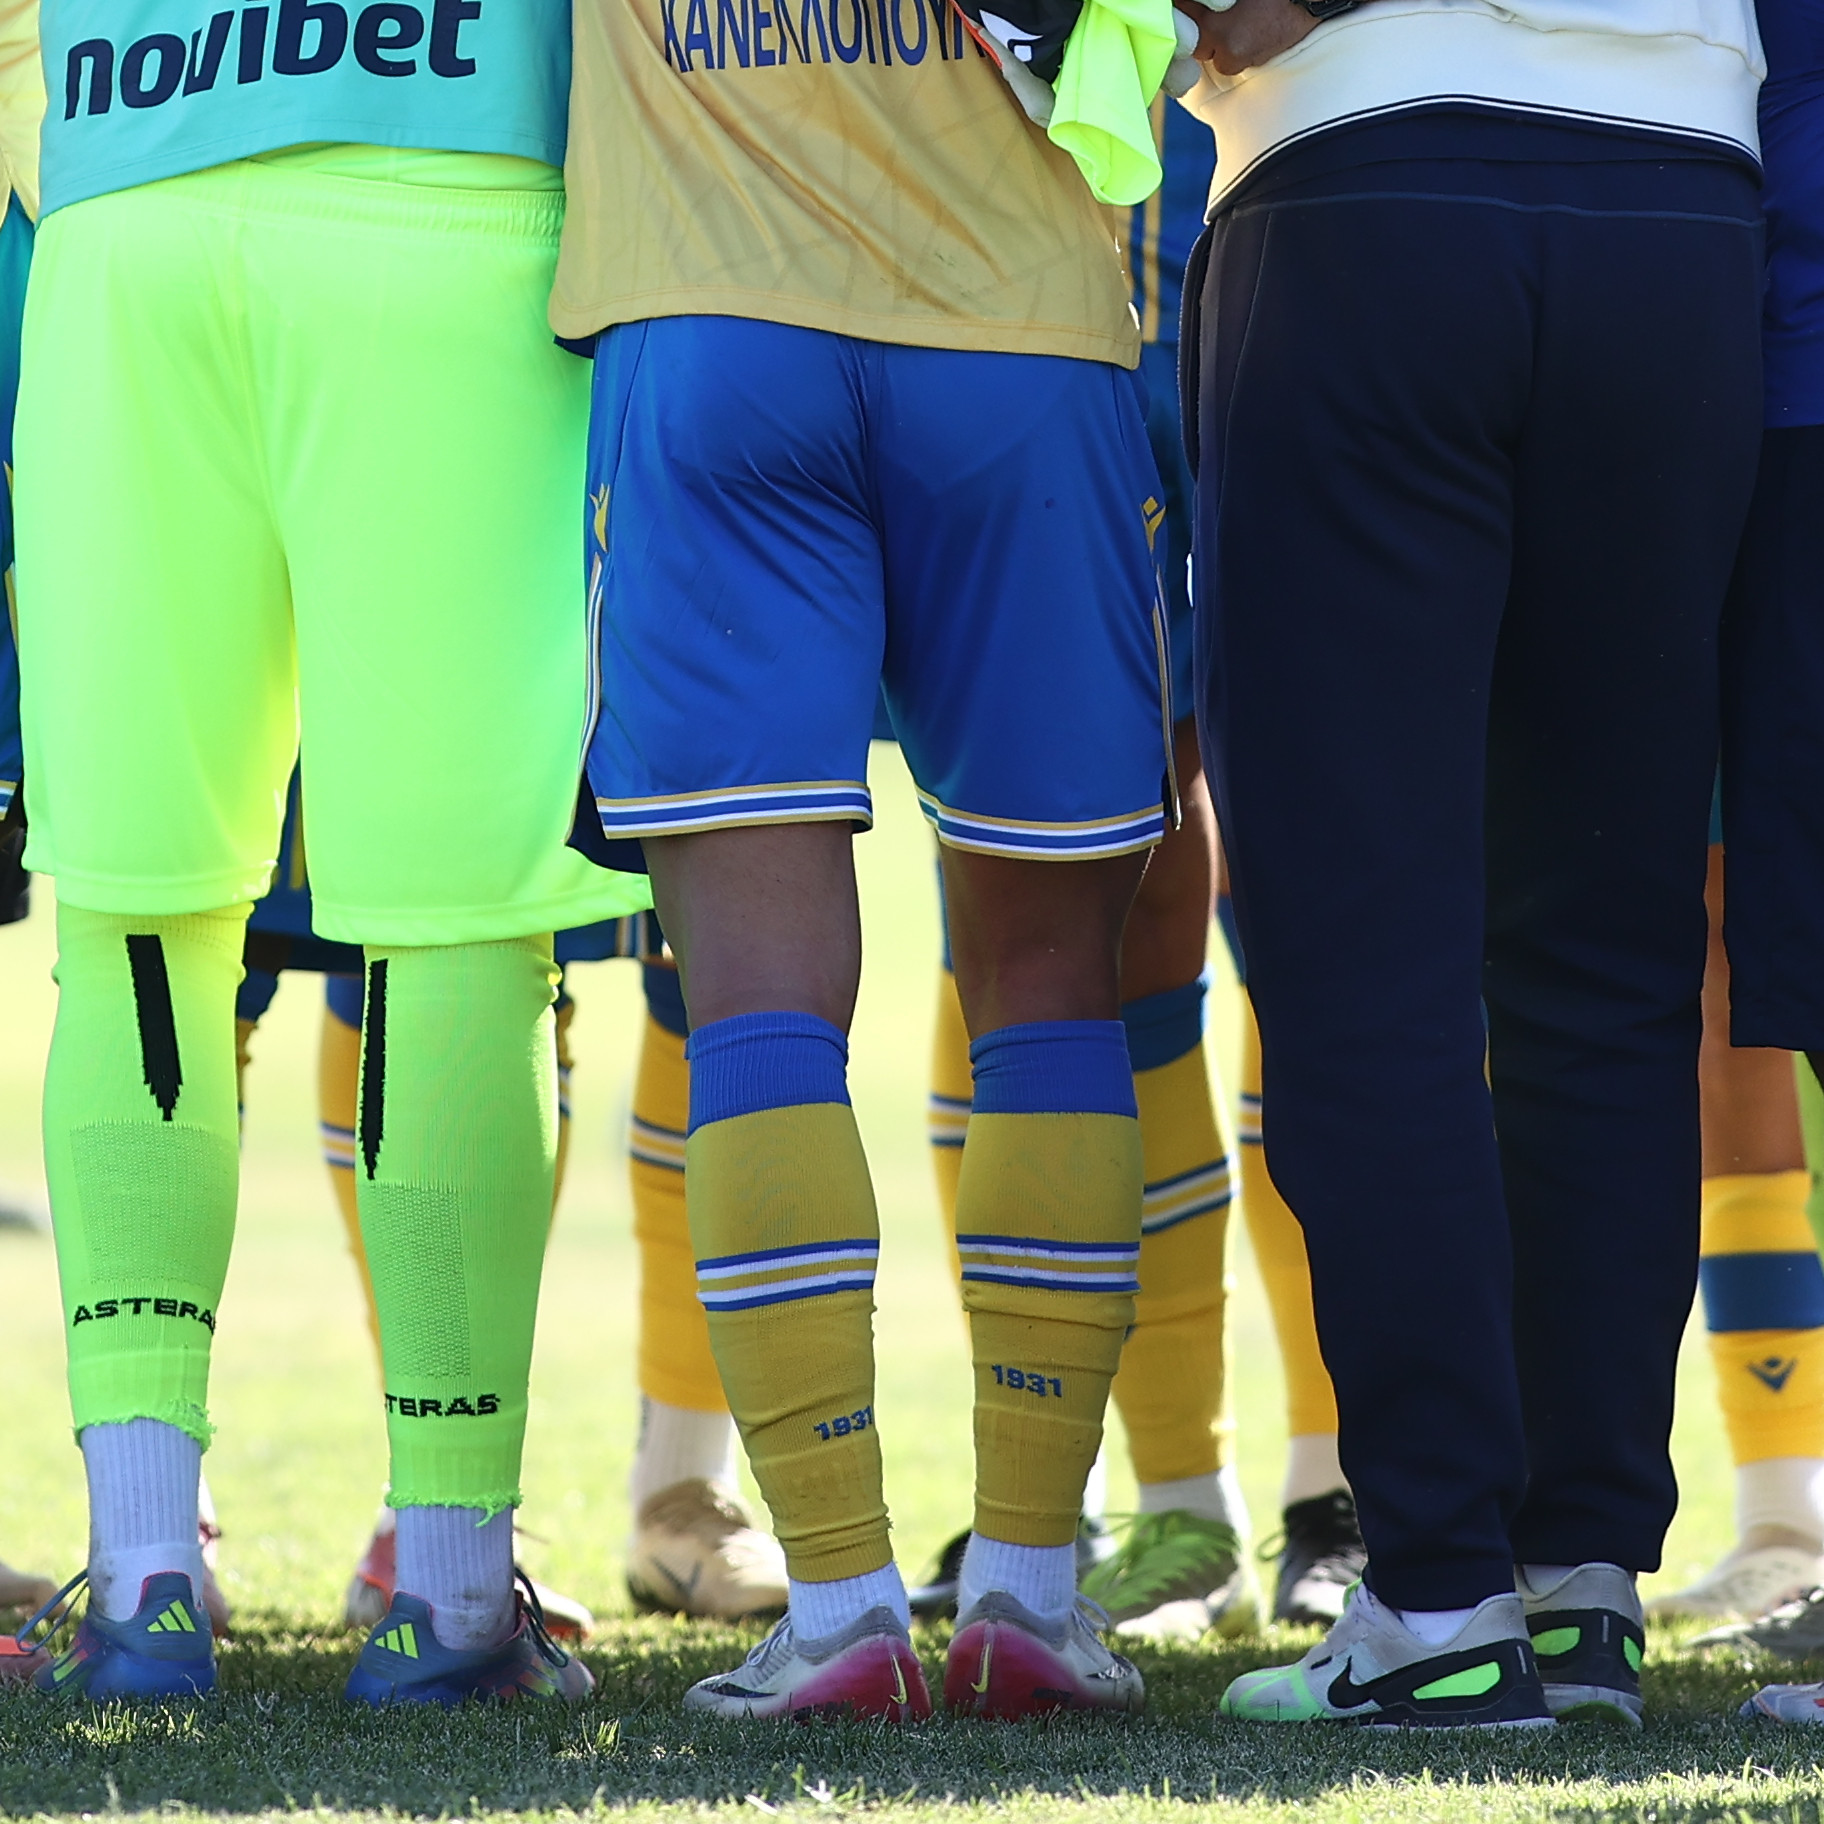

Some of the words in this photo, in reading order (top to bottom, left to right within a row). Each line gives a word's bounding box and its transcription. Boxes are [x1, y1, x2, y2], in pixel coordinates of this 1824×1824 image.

[73, 1297, 217, 1336] ASTERA
[990, 1363, 1062, 1398] 1931
[384, 1393, 501, 1417] TERAS
